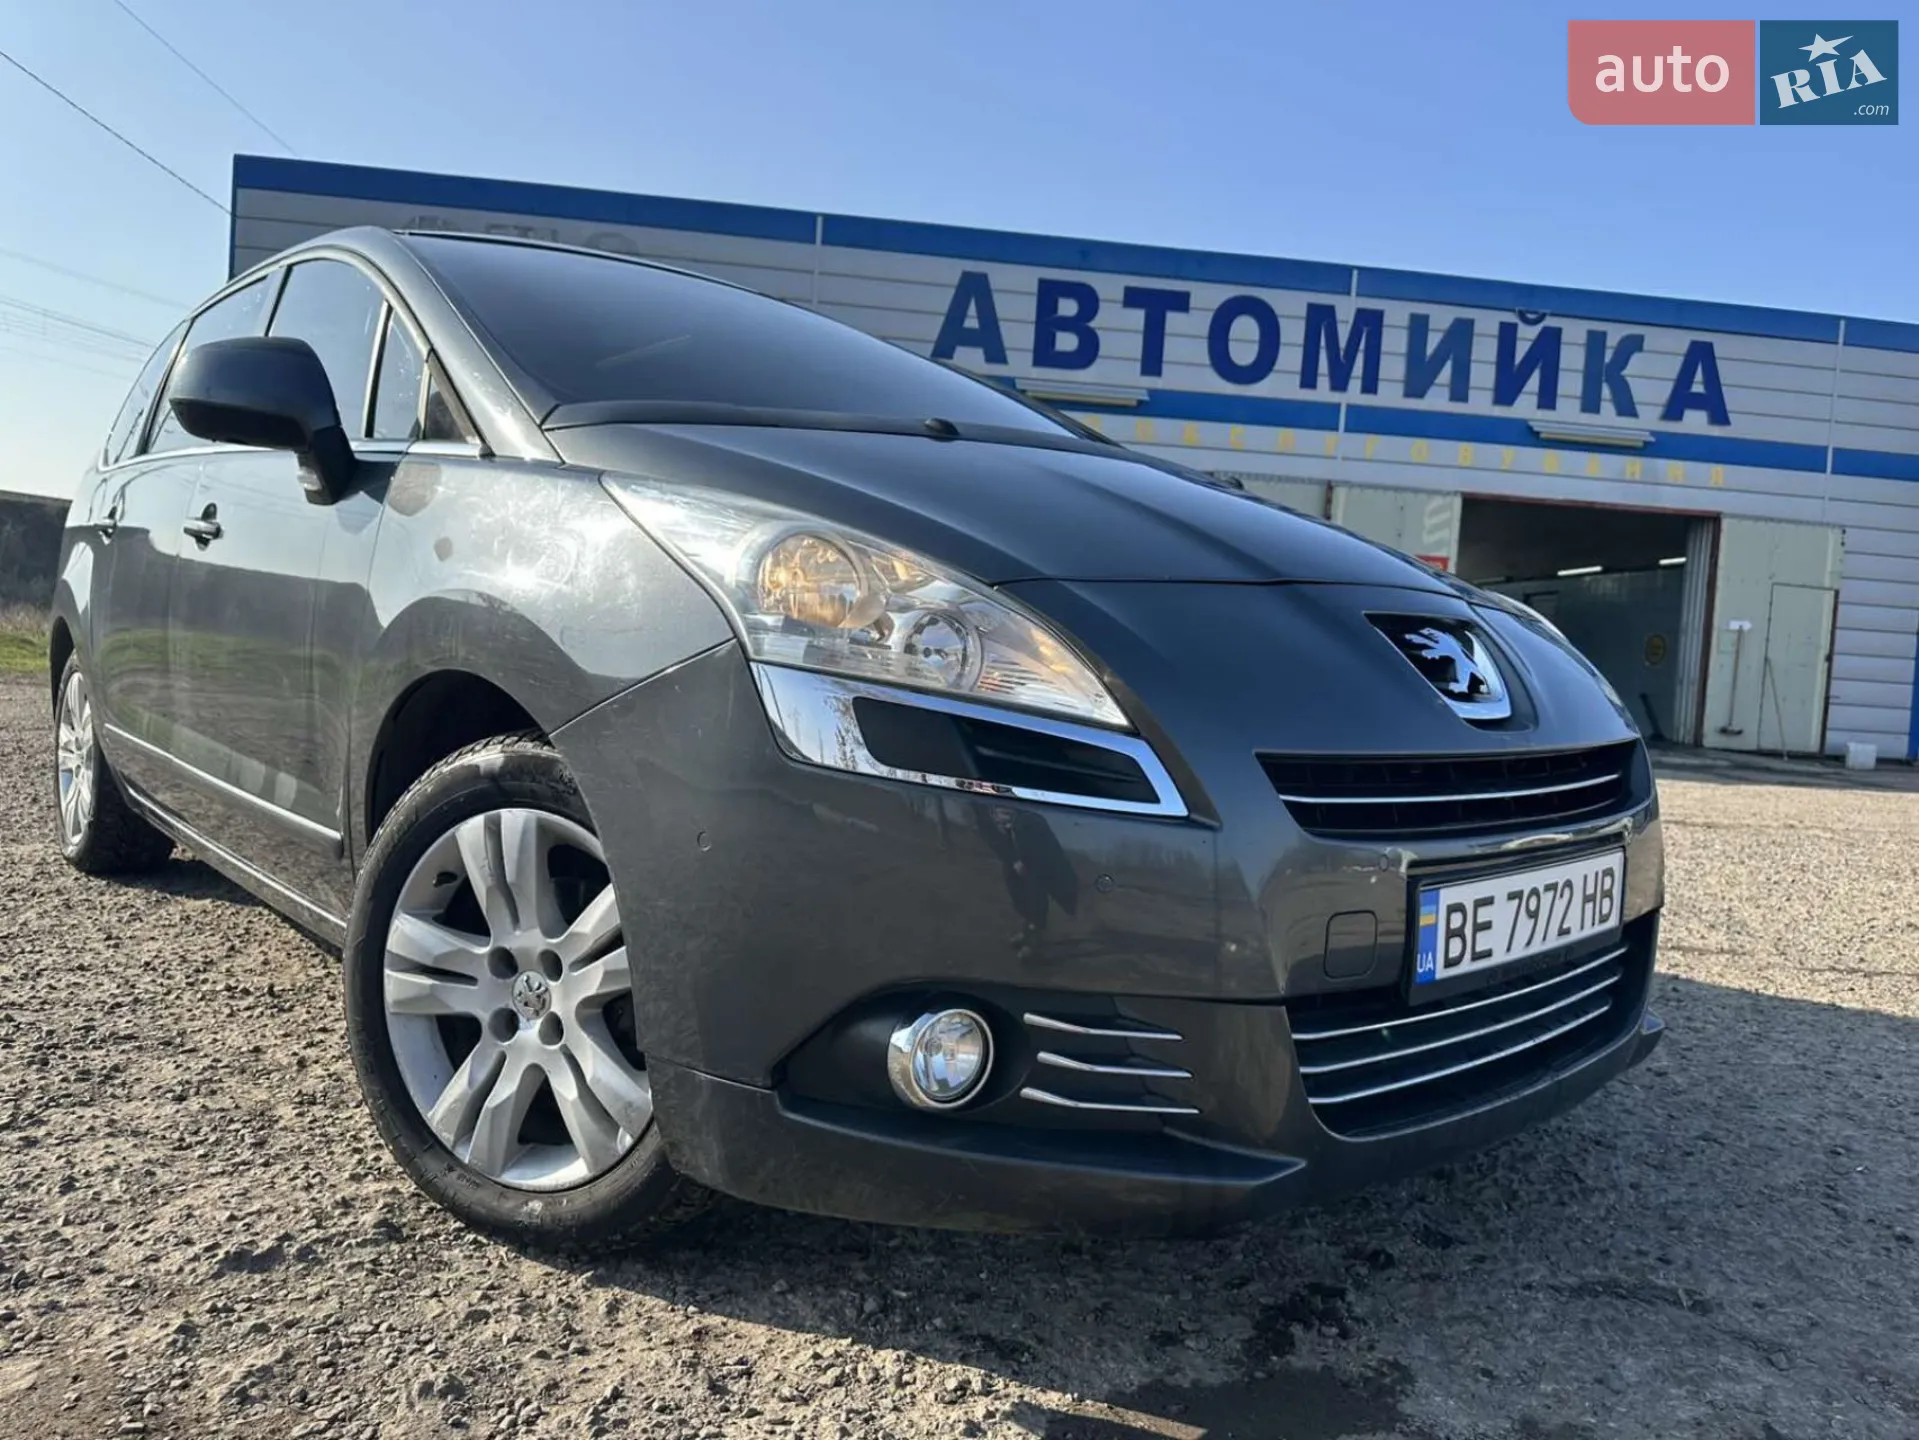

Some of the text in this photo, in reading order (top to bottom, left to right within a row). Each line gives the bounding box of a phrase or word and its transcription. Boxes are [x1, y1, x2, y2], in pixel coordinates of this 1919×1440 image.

[931, 269, 1732, 427] АВТОМИЙКА
[1416, 951, 1435, 973] UA
[1443, 895, 1495, 969] BE
[1505, 878, 1575, 953] 7972
[1580, 866, 1615, 931] HB
